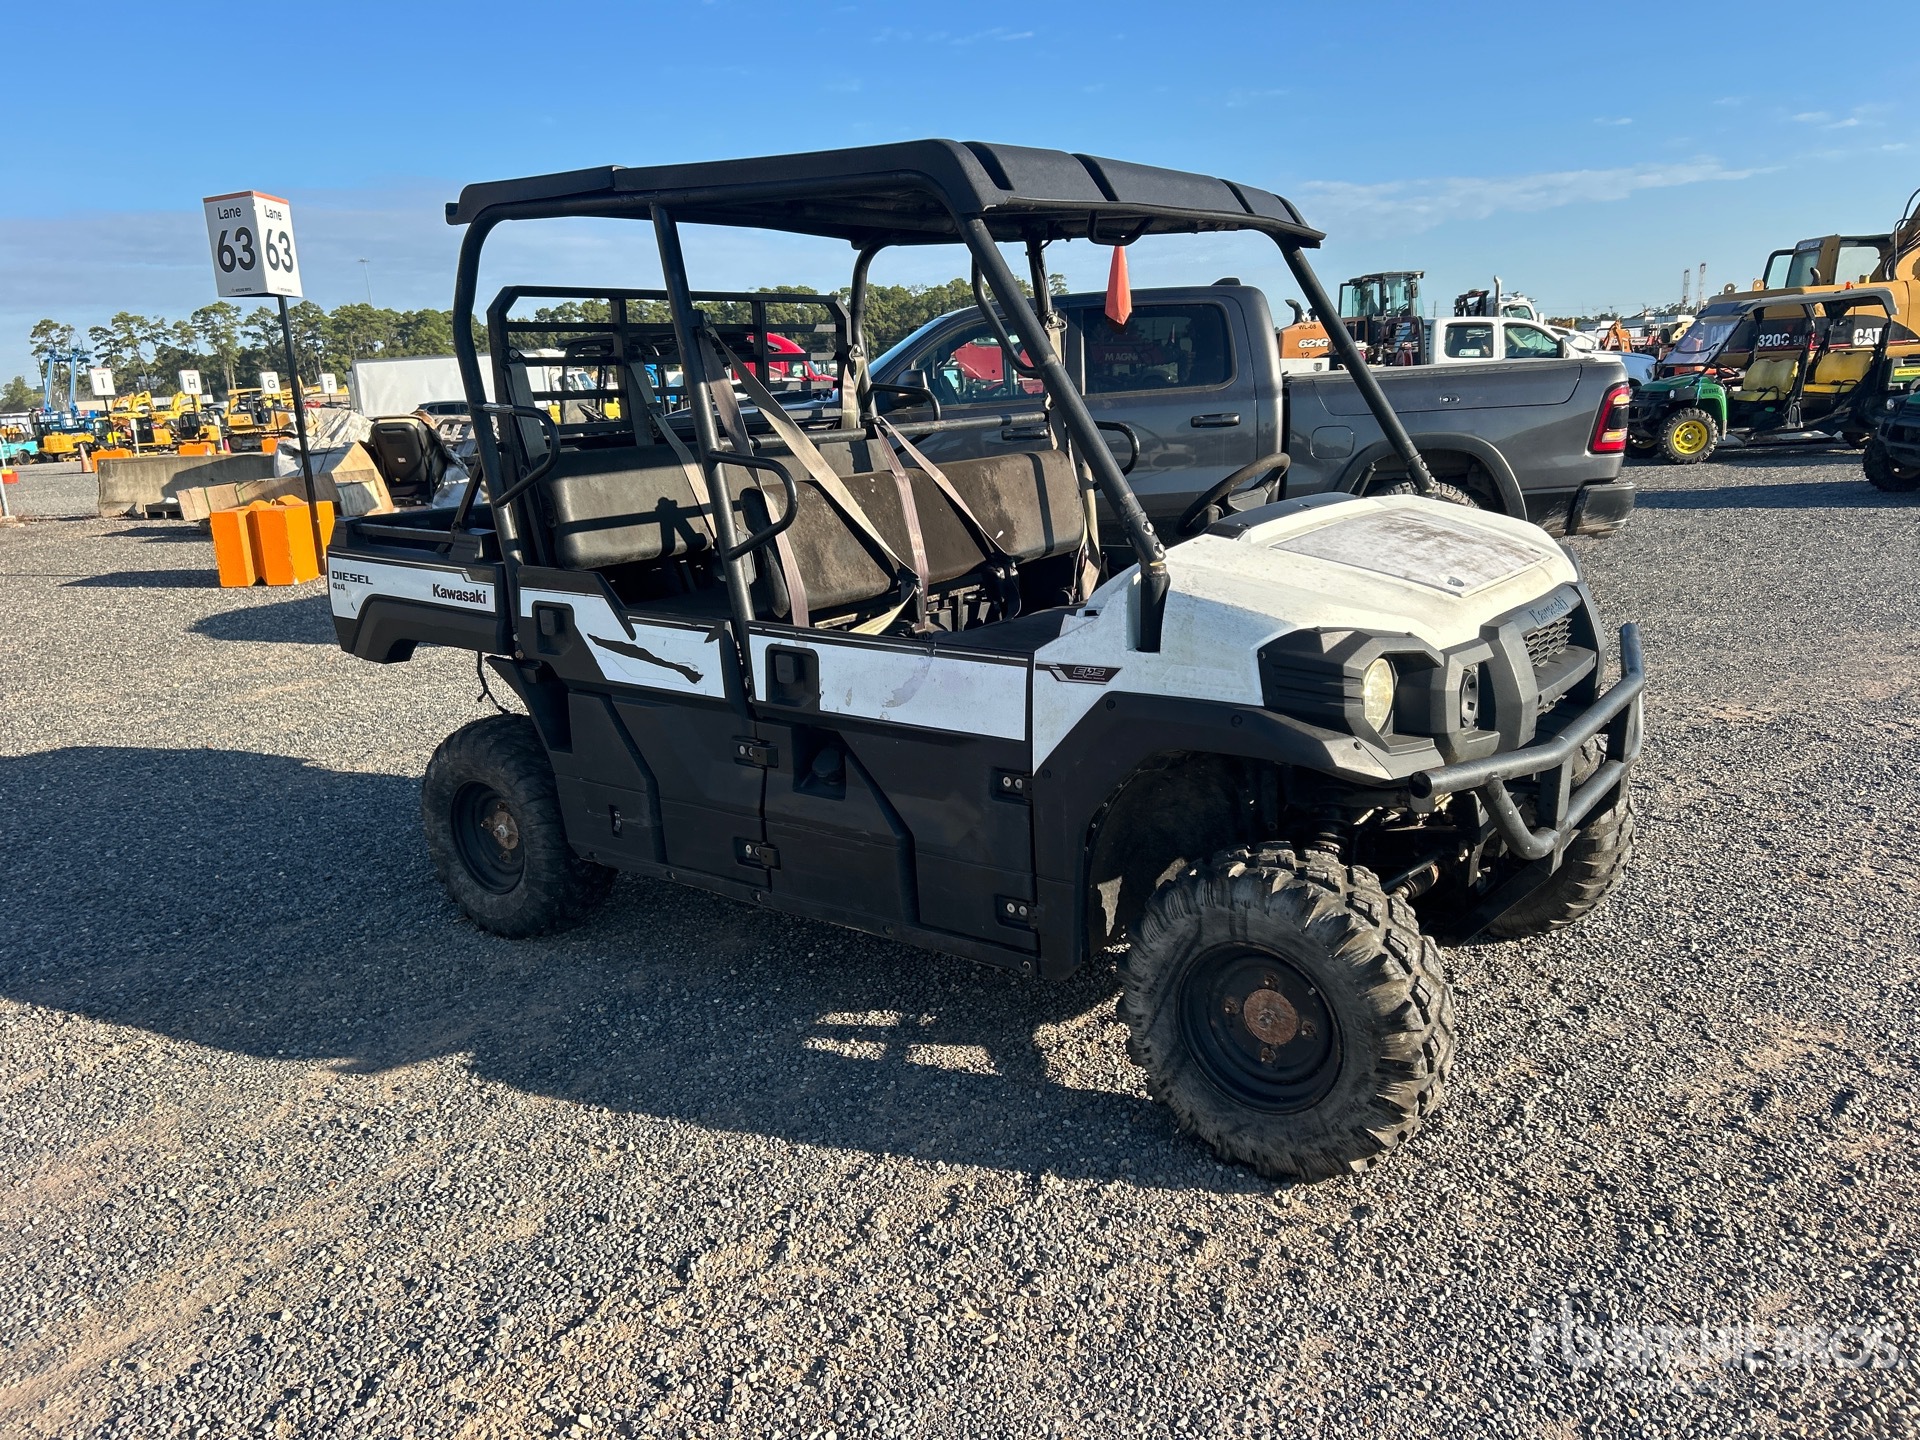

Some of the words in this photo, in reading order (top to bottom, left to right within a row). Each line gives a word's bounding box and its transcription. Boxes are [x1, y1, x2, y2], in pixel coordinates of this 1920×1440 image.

[217, 206, 242, 220] Lane
[264, 204, 282, 221] Lane
[217, 226, 256, 273] 63
[266, 228, 294, 274] 63
[1298, 338, 1329, 348] 621G
[1854, 327, 1883, 346] CAT
[187, 378, 196, 388] H
[267, 379, 276, 389] G
[328, 380, 333, 389] F
[332, 570, 374, 585] DIESEL
[432, 583, 487, 605] Kawasaki
[1073, 666, 1106, 678] EPS
